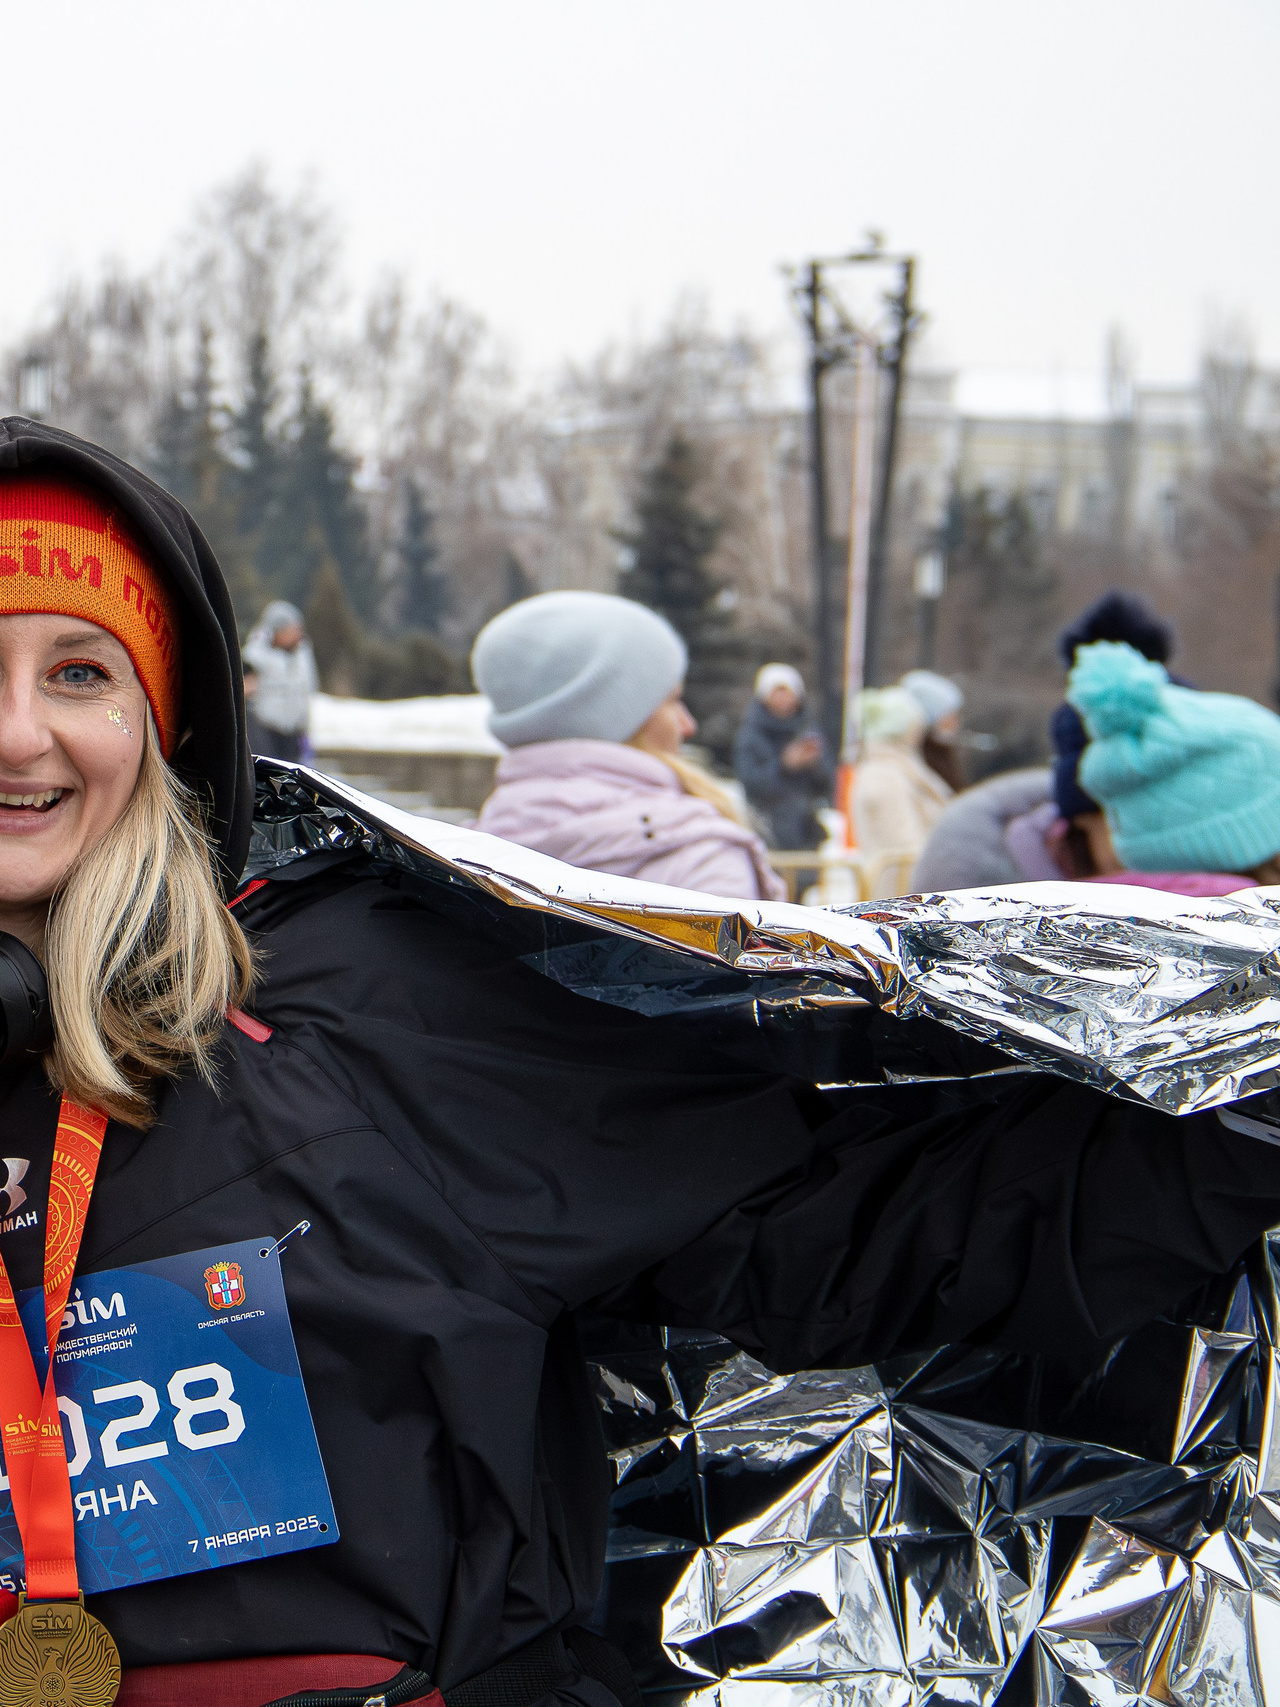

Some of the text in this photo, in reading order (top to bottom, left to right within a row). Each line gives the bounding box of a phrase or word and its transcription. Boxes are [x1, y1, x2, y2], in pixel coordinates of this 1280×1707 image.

[197, 1309, 266, 1330] ОМСКАЯ ОБЛАСТЬ
[56, 1338, 133, 1364] ПОЛУМАРАФОН
[74, 1479, 159, 1522] ЯНА
[187, 1514, 319, 1553] 7 ЯНВАРЯ 2025
